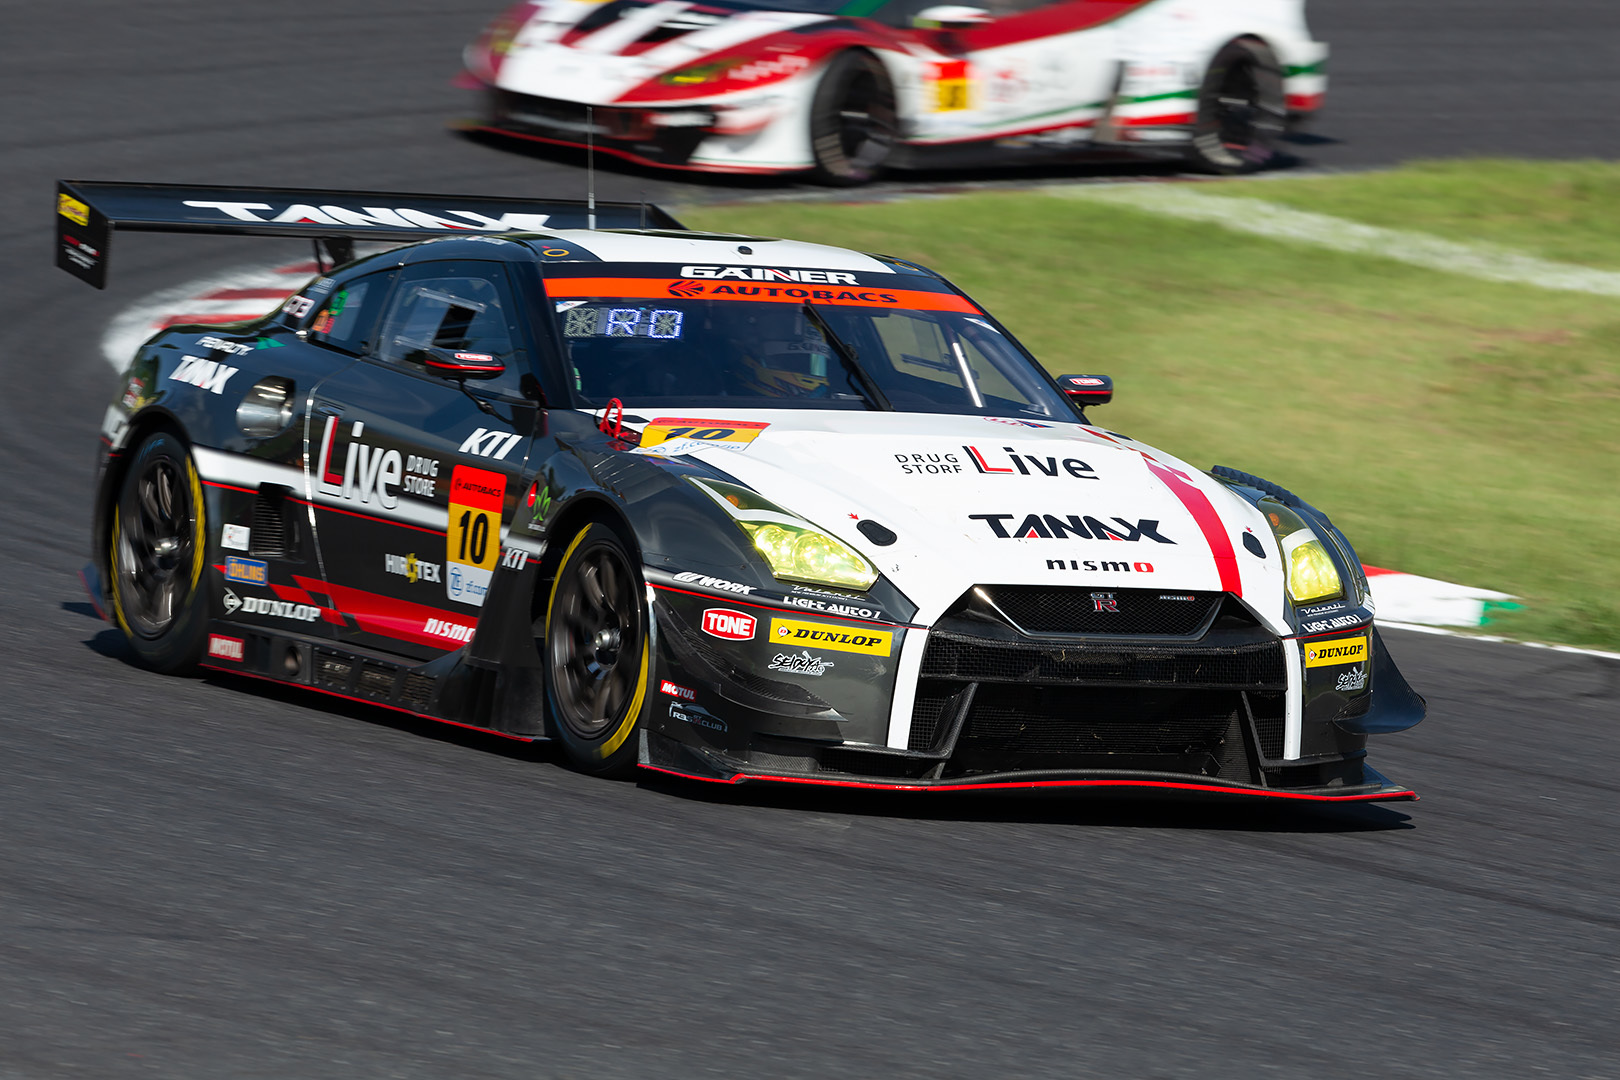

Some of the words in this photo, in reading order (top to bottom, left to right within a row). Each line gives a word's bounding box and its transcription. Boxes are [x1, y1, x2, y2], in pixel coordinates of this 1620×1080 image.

[182, 200, 555, 233] TANAX
[680, 265, 861, 286] GAINER
[709, 284, 899, 304] AUTOBACS
[168, 355, 240, 395] TANAX
[458, 427, 523, 460] KTI
[664, 427, 736, 441] 10
[317, 415, 402, 510] Live
[406, 454, 440, 478] DRUG
[894, 453, 959, 463] DRUG
[961, 445, 1100, 481] Live
[402, 475, 436, 498] STORE
[459, 510, 489, 565] 10
[968, 513, 1179, 545] TANAX
[384, 552, 442, 583] HIROTEX
[502, 547, 530, 571] KTI
[1046, 559, 1155, 573] nismo
[693, 573, 758, 597] WORK
[240, 596, 322, 622] DUNLOP
[707, 612, 752, 637] TONE
[793, 627, 883, 647] DUNLOP
[1317, 644, 1364, 659] DUNLOP
[661, 682, 696, 700] MOTUL
